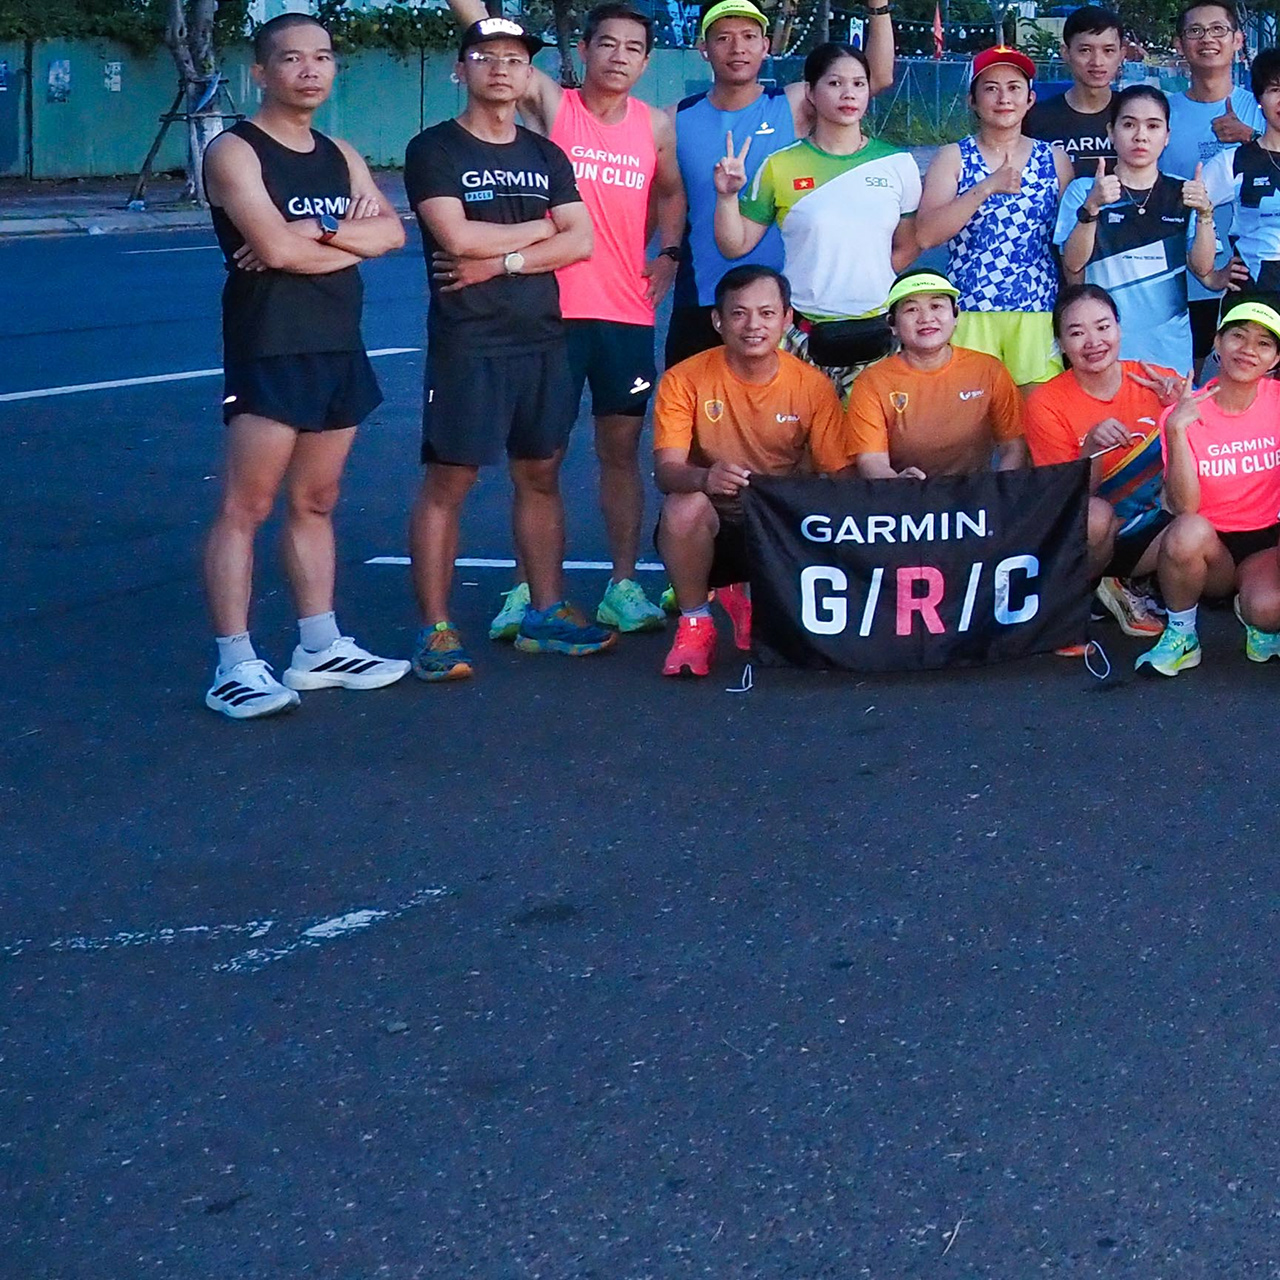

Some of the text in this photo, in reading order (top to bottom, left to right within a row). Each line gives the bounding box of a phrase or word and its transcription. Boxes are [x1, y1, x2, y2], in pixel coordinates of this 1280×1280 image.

[570, 145, 640, 167] GARMIN
[1051, 137, 1114, 153] GARM
[461, 169, 551, 191] GARMIN
[572, 161, 646, 191] UN CLUB
[1207, 436, 1276, 457] GARMIN
[1199, 457, 1236, 478] RUN
[801, 509, 987, 544] GARMIN
[800, 554, 1040, 636] G/R/C
